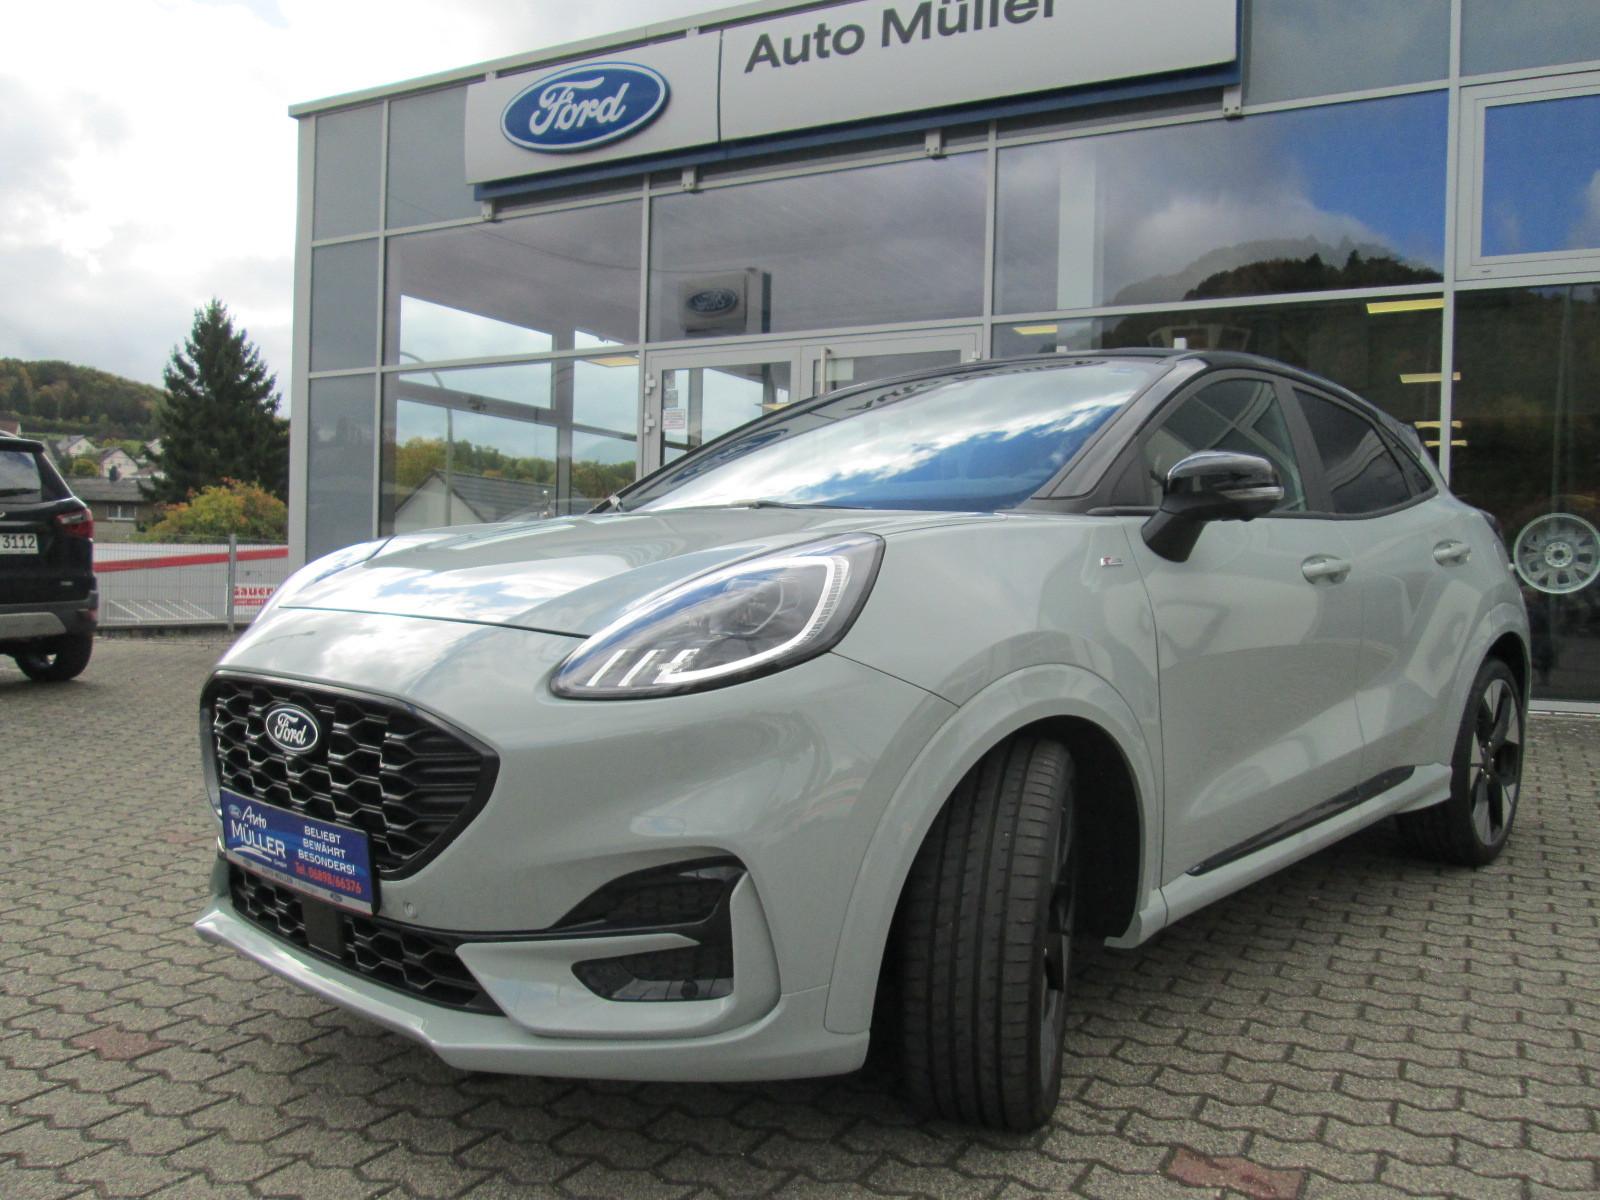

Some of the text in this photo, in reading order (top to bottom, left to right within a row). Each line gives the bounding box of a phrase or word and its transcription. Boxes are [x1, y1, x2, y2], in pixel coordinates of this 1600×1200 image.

[744, 0, 1055, 74] Auto Müller
[529, 76, 630, 135] Ford
[2, 535, 36, 549] 3112
[274, 712, 307, 745] Ford
[242, 805, 267, 829] Auto
[231, 819, 286, 859] MÜLLER
[302, 838, 346, 859] BEWÄHRT
[304, 825, 341, 845] BELIEBT
[298, 849, 355, 876] BESONDERS!
